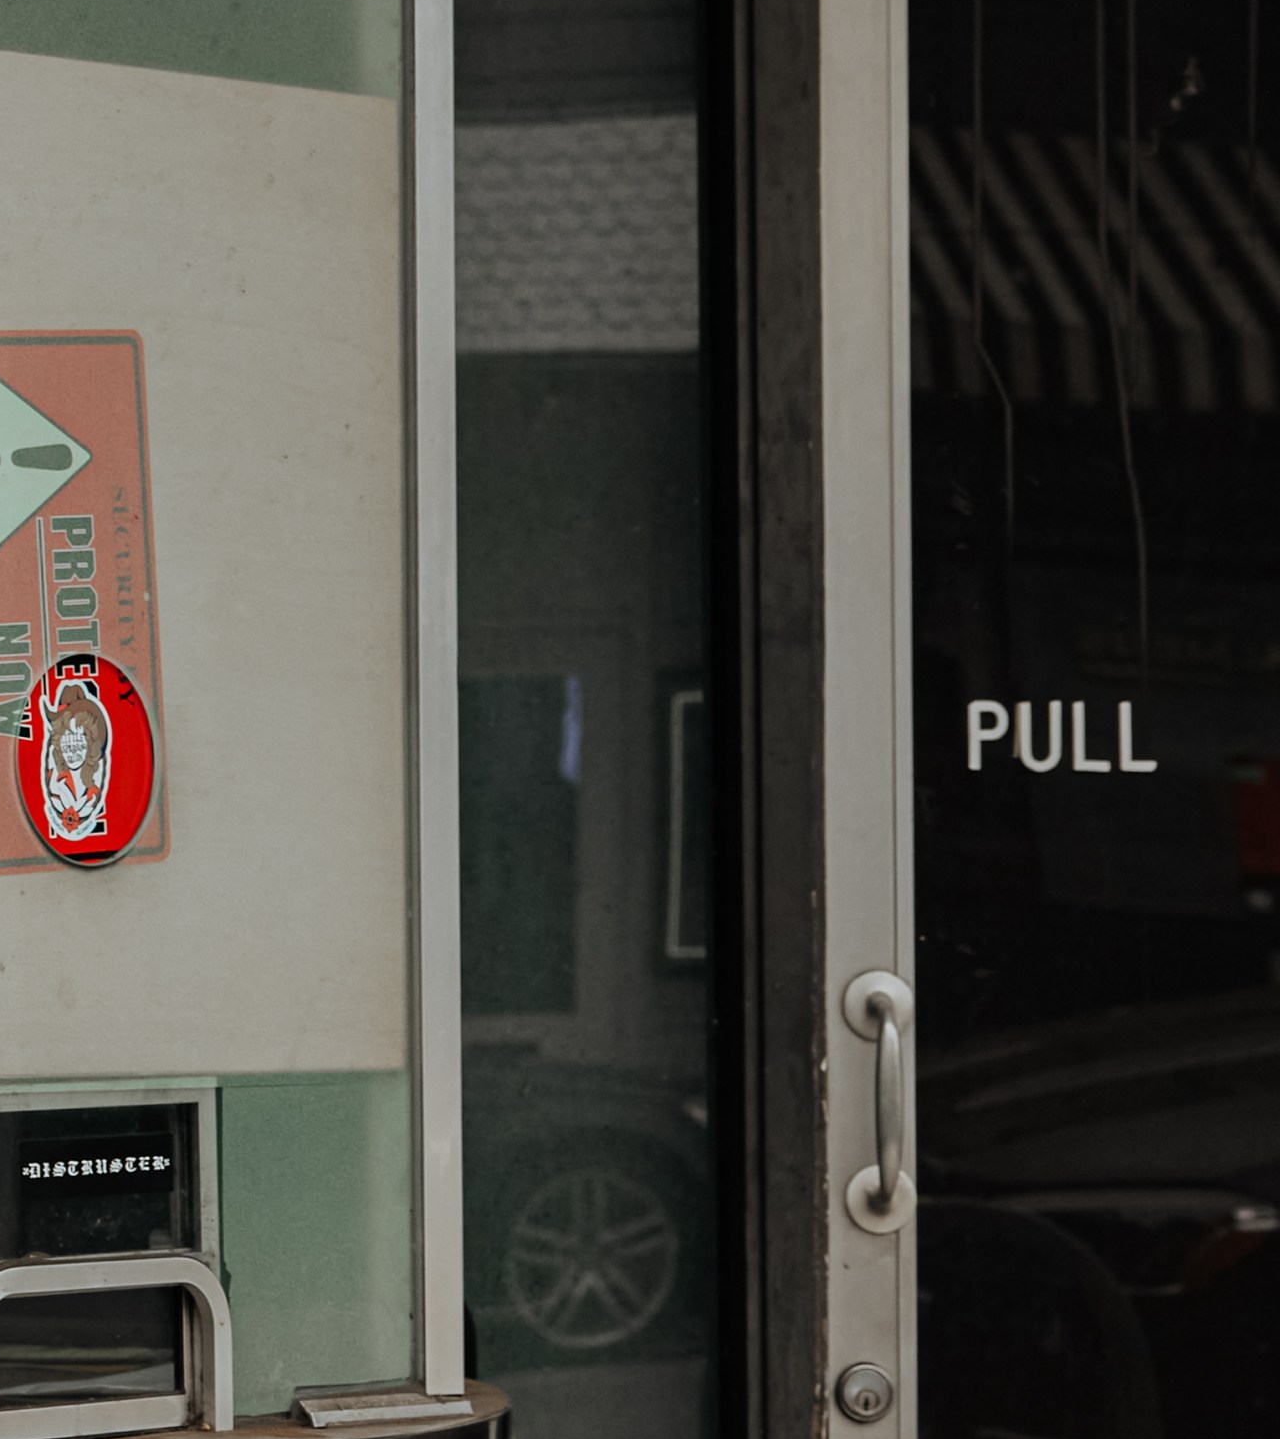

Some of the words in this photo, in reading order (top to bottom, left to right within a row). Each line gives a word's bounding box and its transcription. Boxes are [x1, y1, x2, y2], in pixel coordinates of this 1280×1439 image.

[112, 487, 135, 649] SECURITY
[116, 661, 139, 708] BY
[966, 699, 1158, 773] PULL
